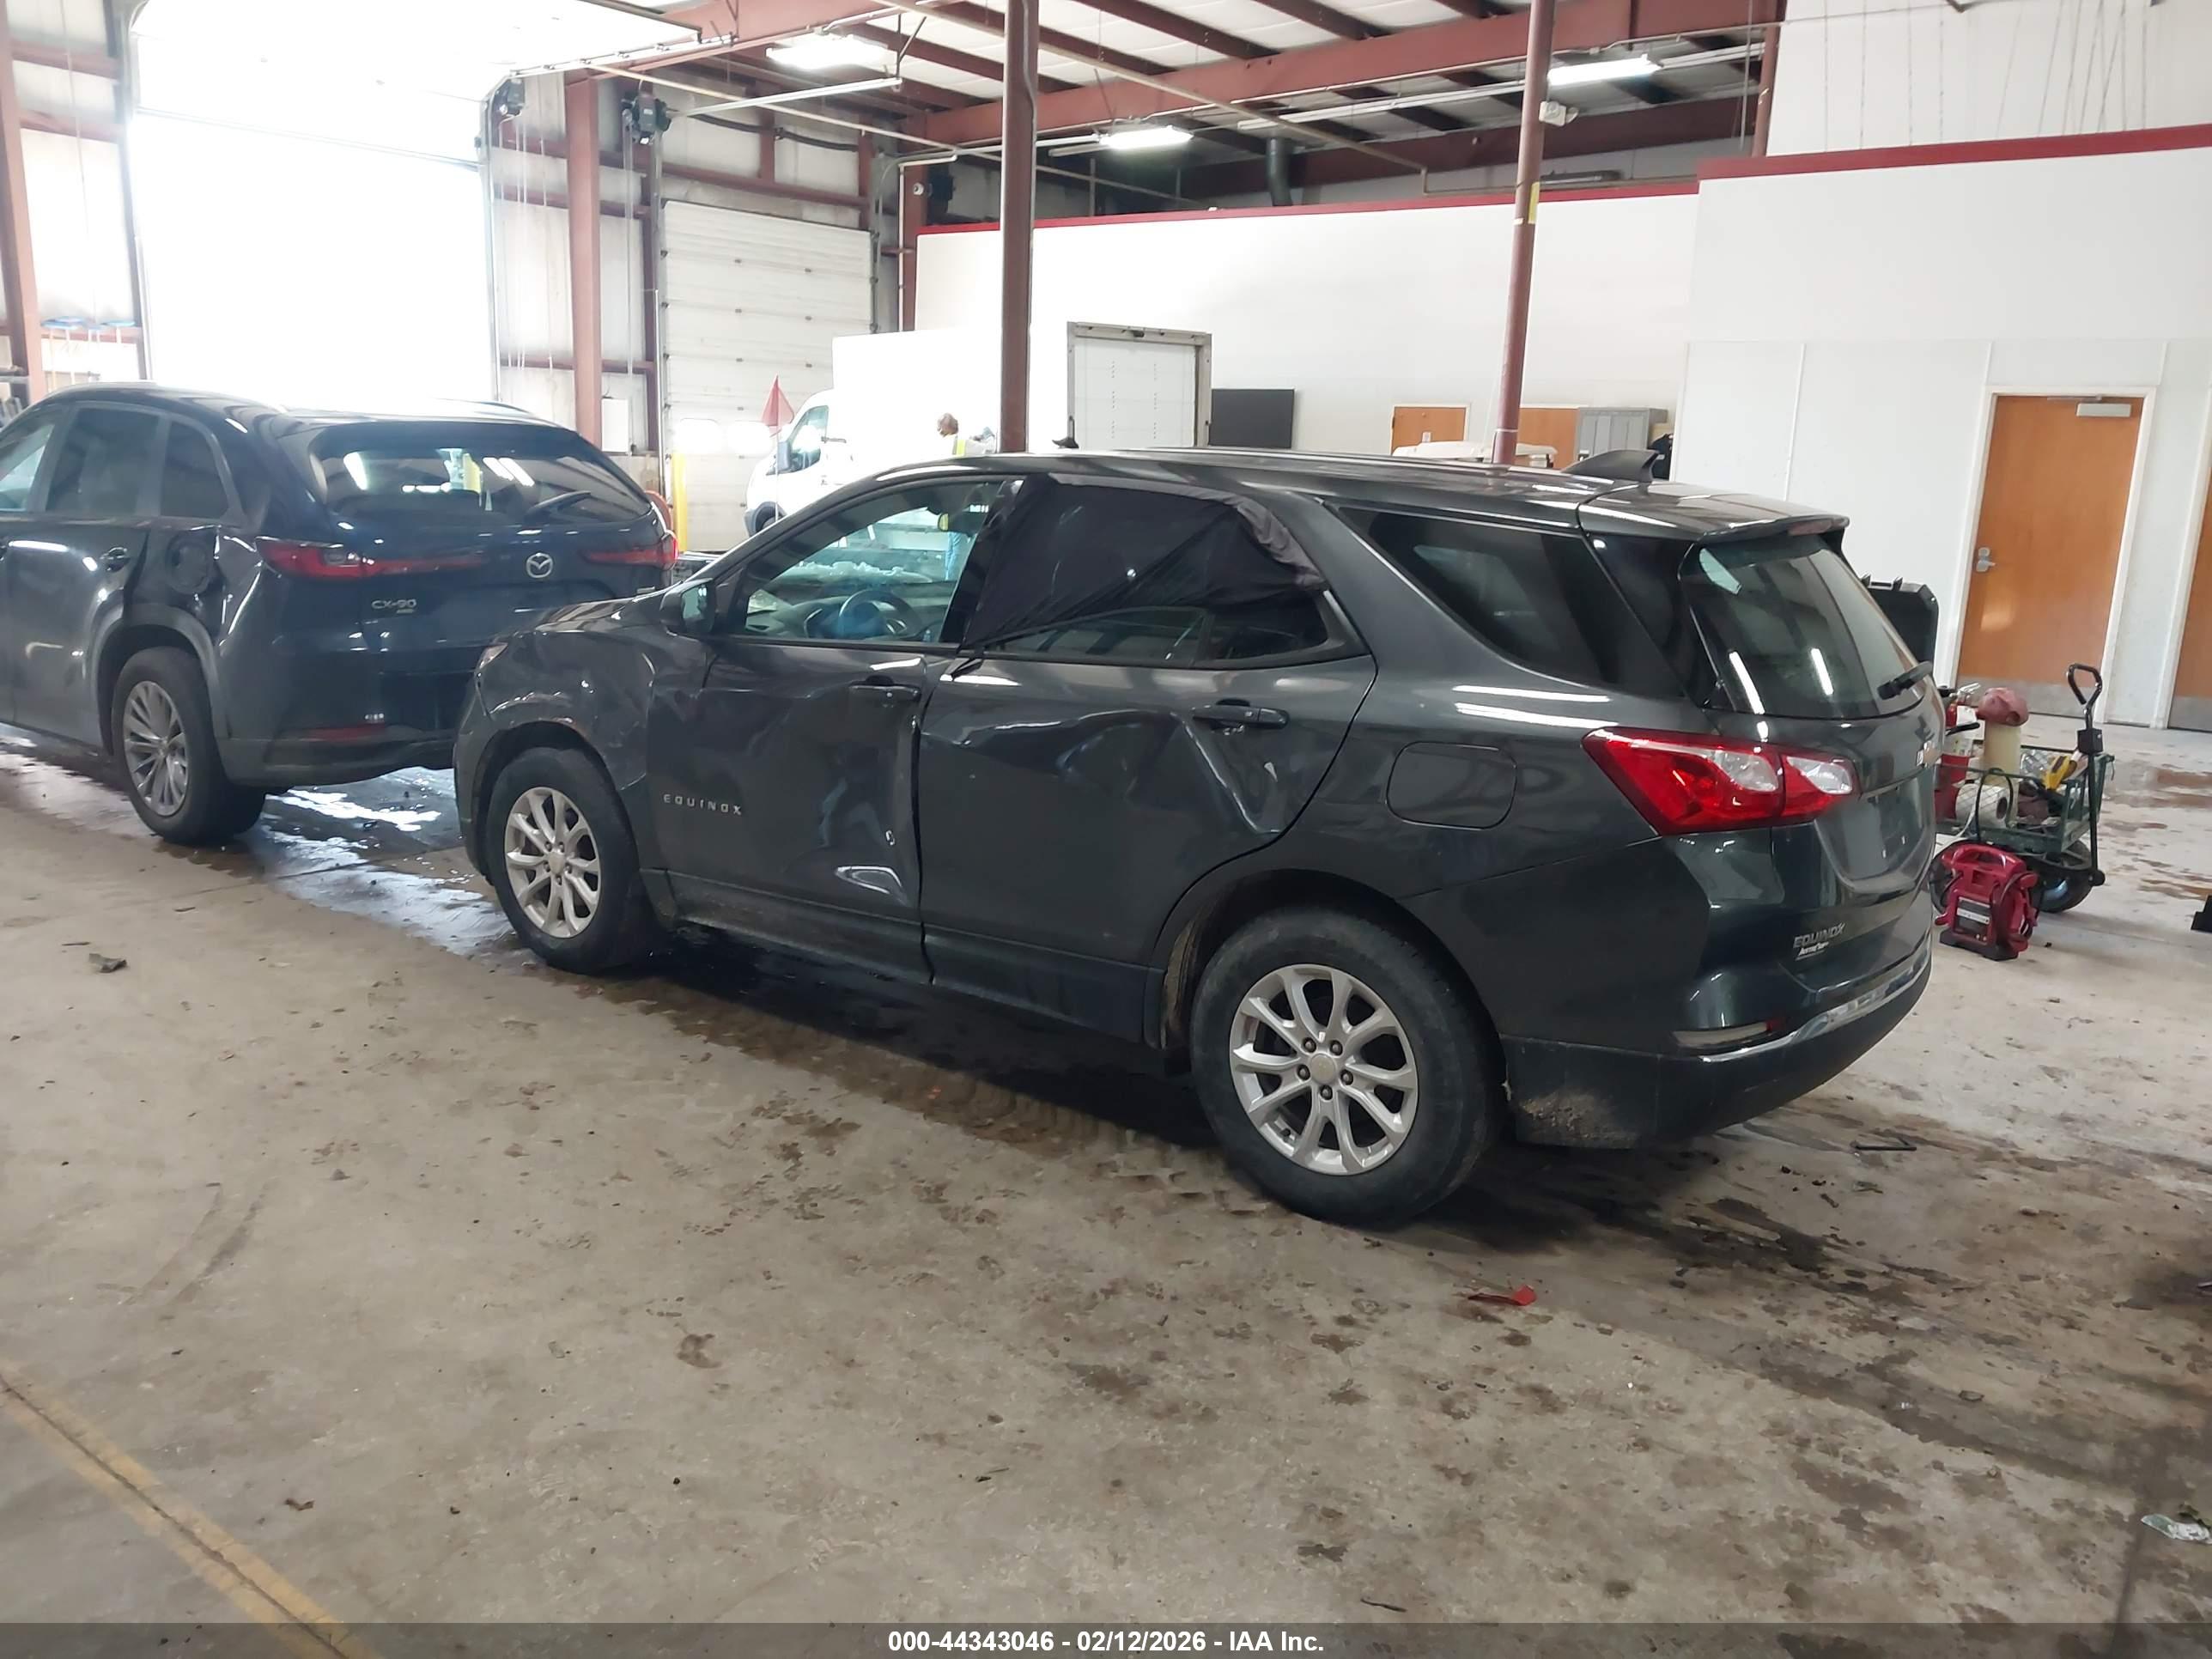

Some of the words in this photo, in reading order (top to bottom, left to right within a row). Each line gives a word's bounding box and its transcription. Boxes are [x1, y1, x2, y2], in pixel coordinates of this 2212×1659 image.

[371, 599, 417, 610] CX-90
[663, 793, 742, 816] EQUINOX
[1792, 921, 1846, 949] EQUINOX
